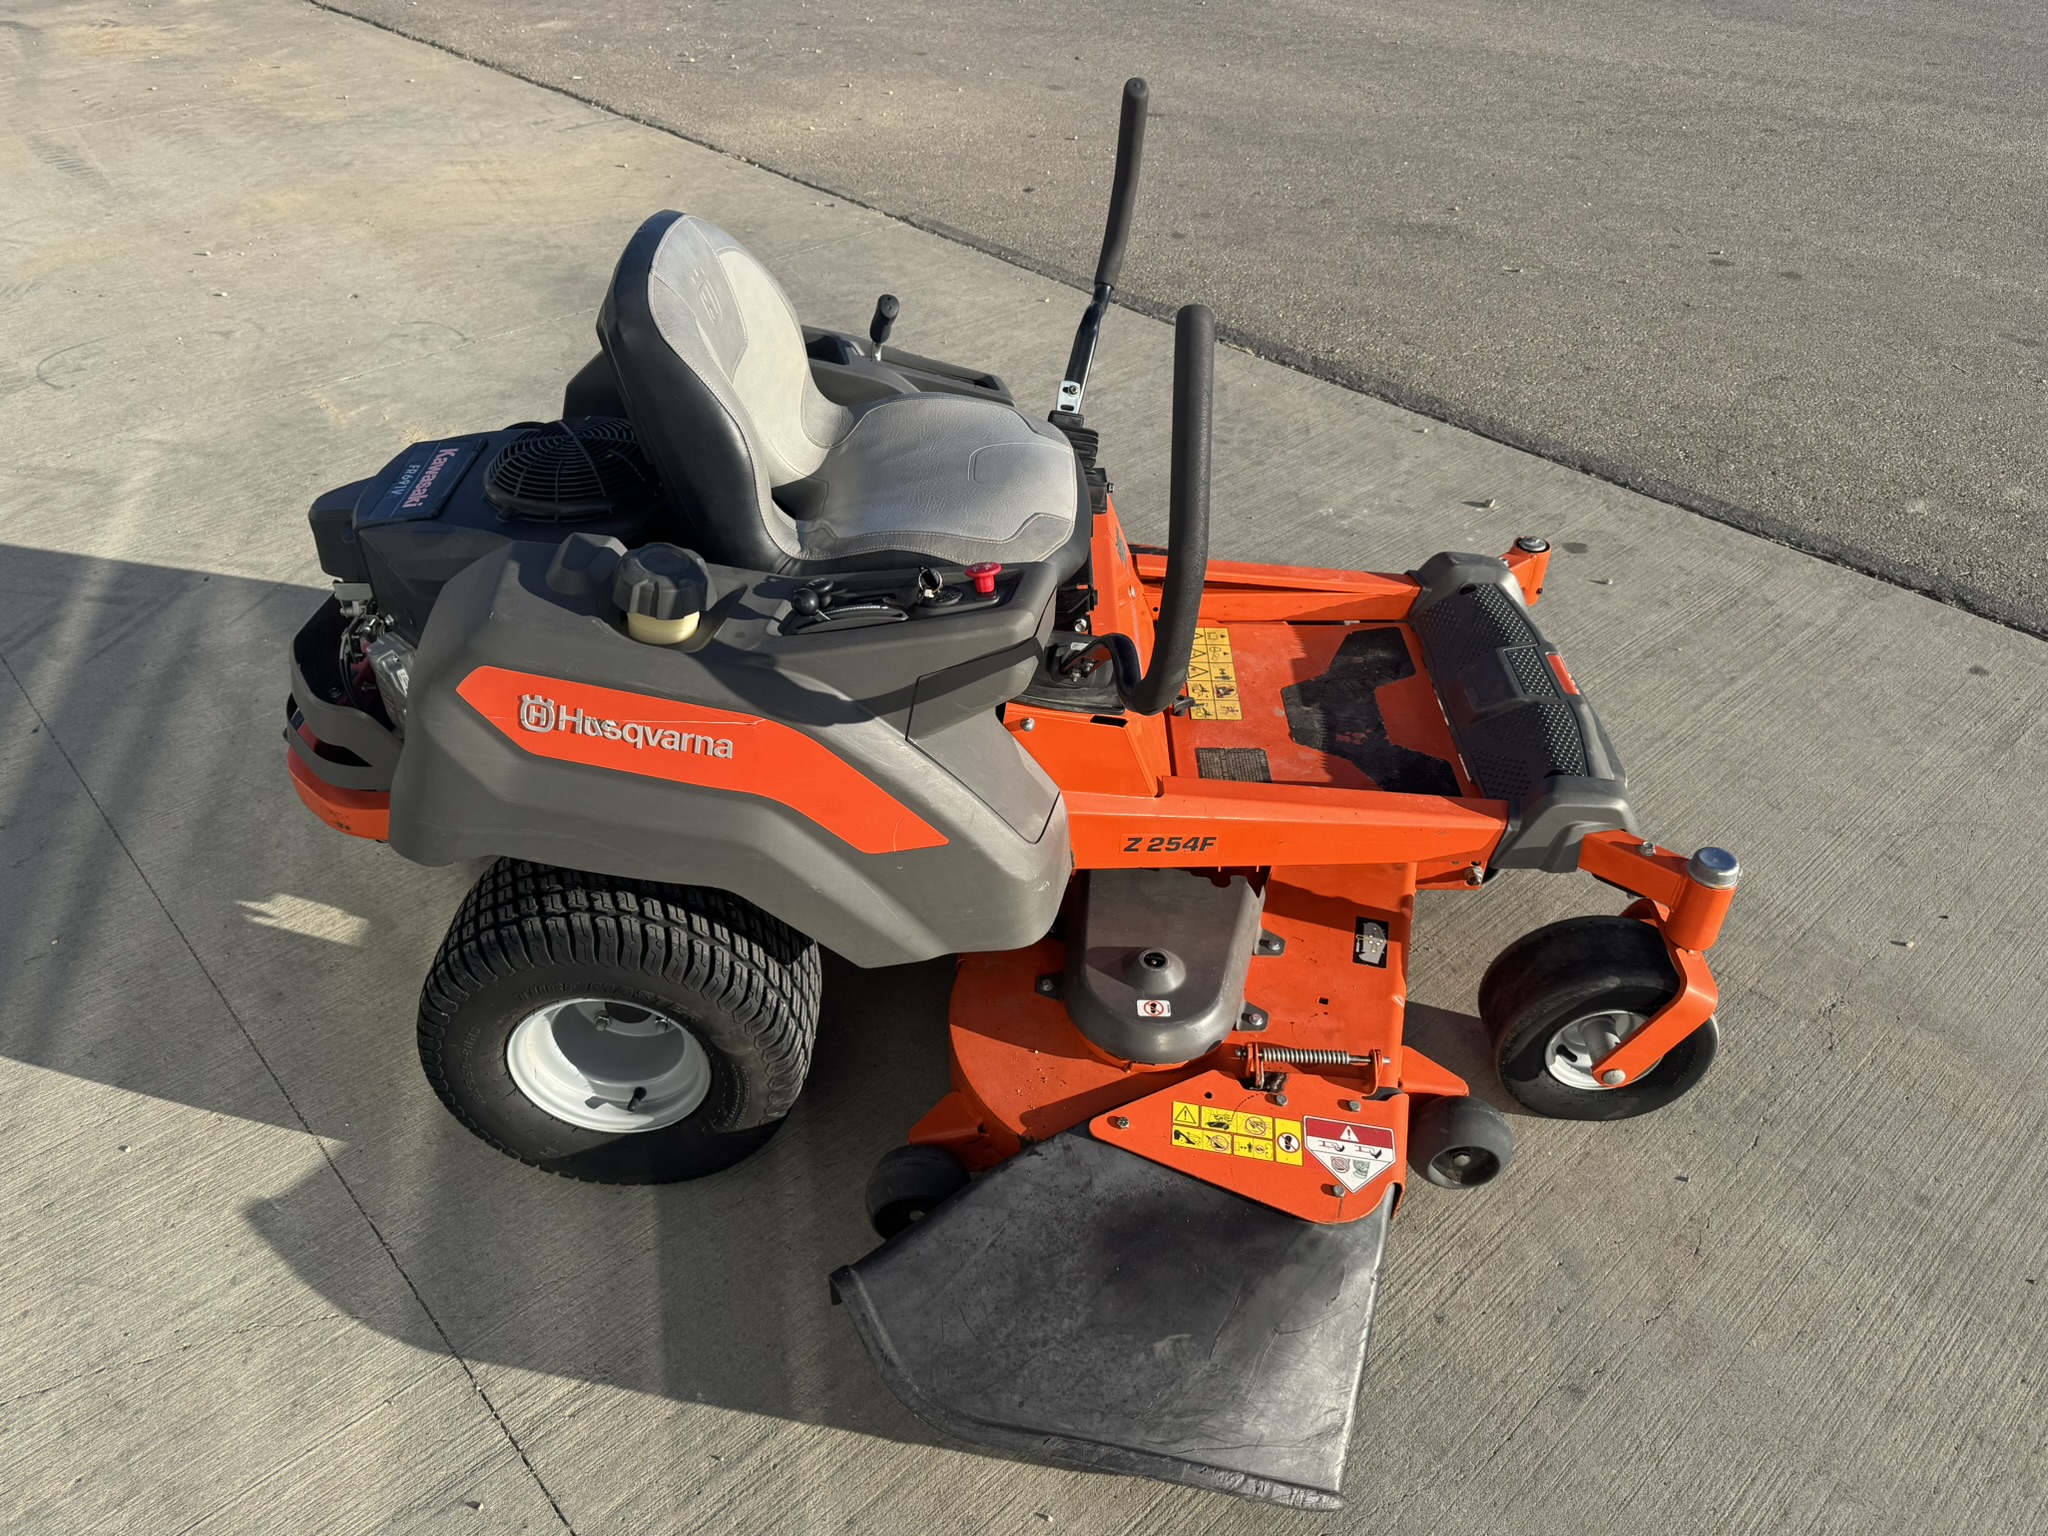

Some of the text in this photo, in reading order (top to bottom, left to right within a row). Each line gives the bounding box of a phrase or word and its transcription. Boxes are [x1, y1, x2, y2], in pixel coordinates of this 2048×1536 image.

[391, 464, 420, 495] FR691V
[402, 448, 459, 508] Kawasaki
[558, 704, 733, 759] Husqvarna
[1123, 836, 1217, 852] Z 254F
